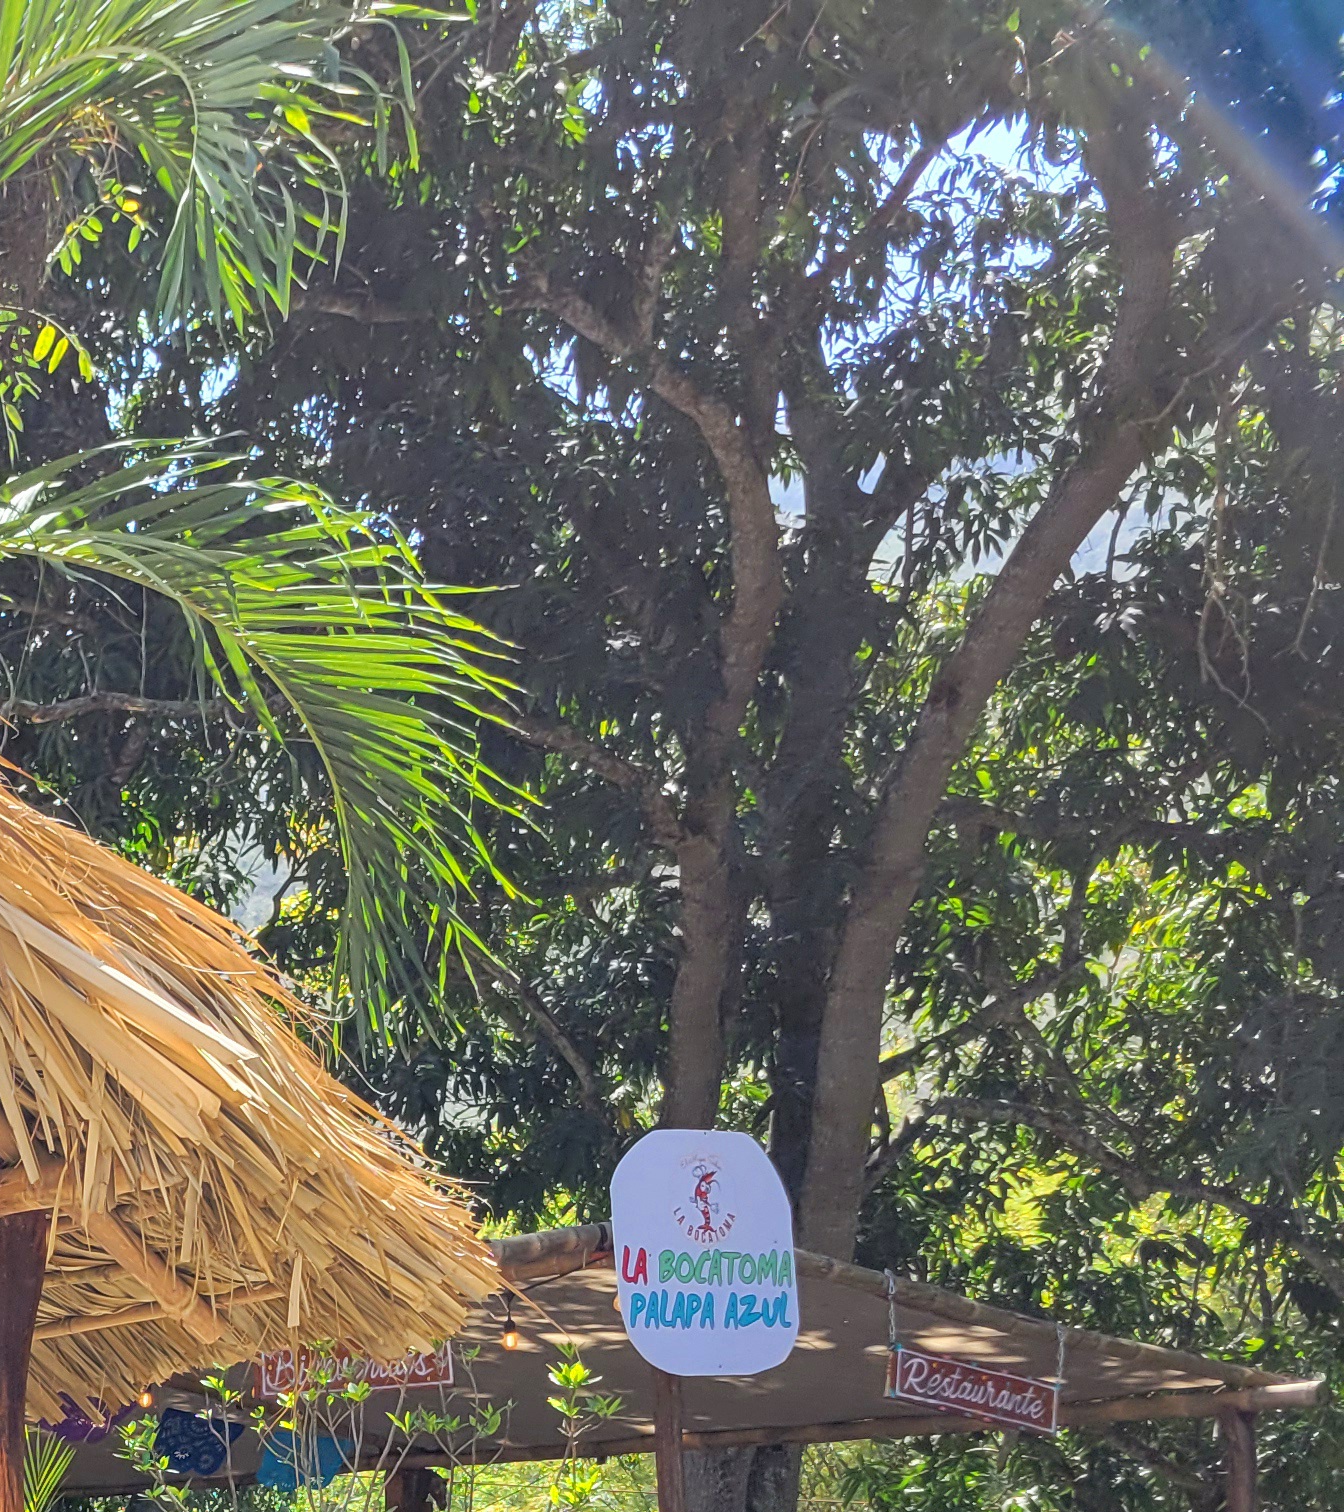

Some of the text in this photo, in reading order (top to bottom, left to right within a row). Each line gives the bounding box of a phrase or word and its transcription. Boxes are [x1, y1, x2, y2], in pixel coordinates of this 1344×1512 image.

[673, 1206, 735, 1243] LA BOCATOMA
[621, 1245, 793, 1287] LA BOCATOMA
[629, 1289, 792, 1330] PALAPA AZUL
